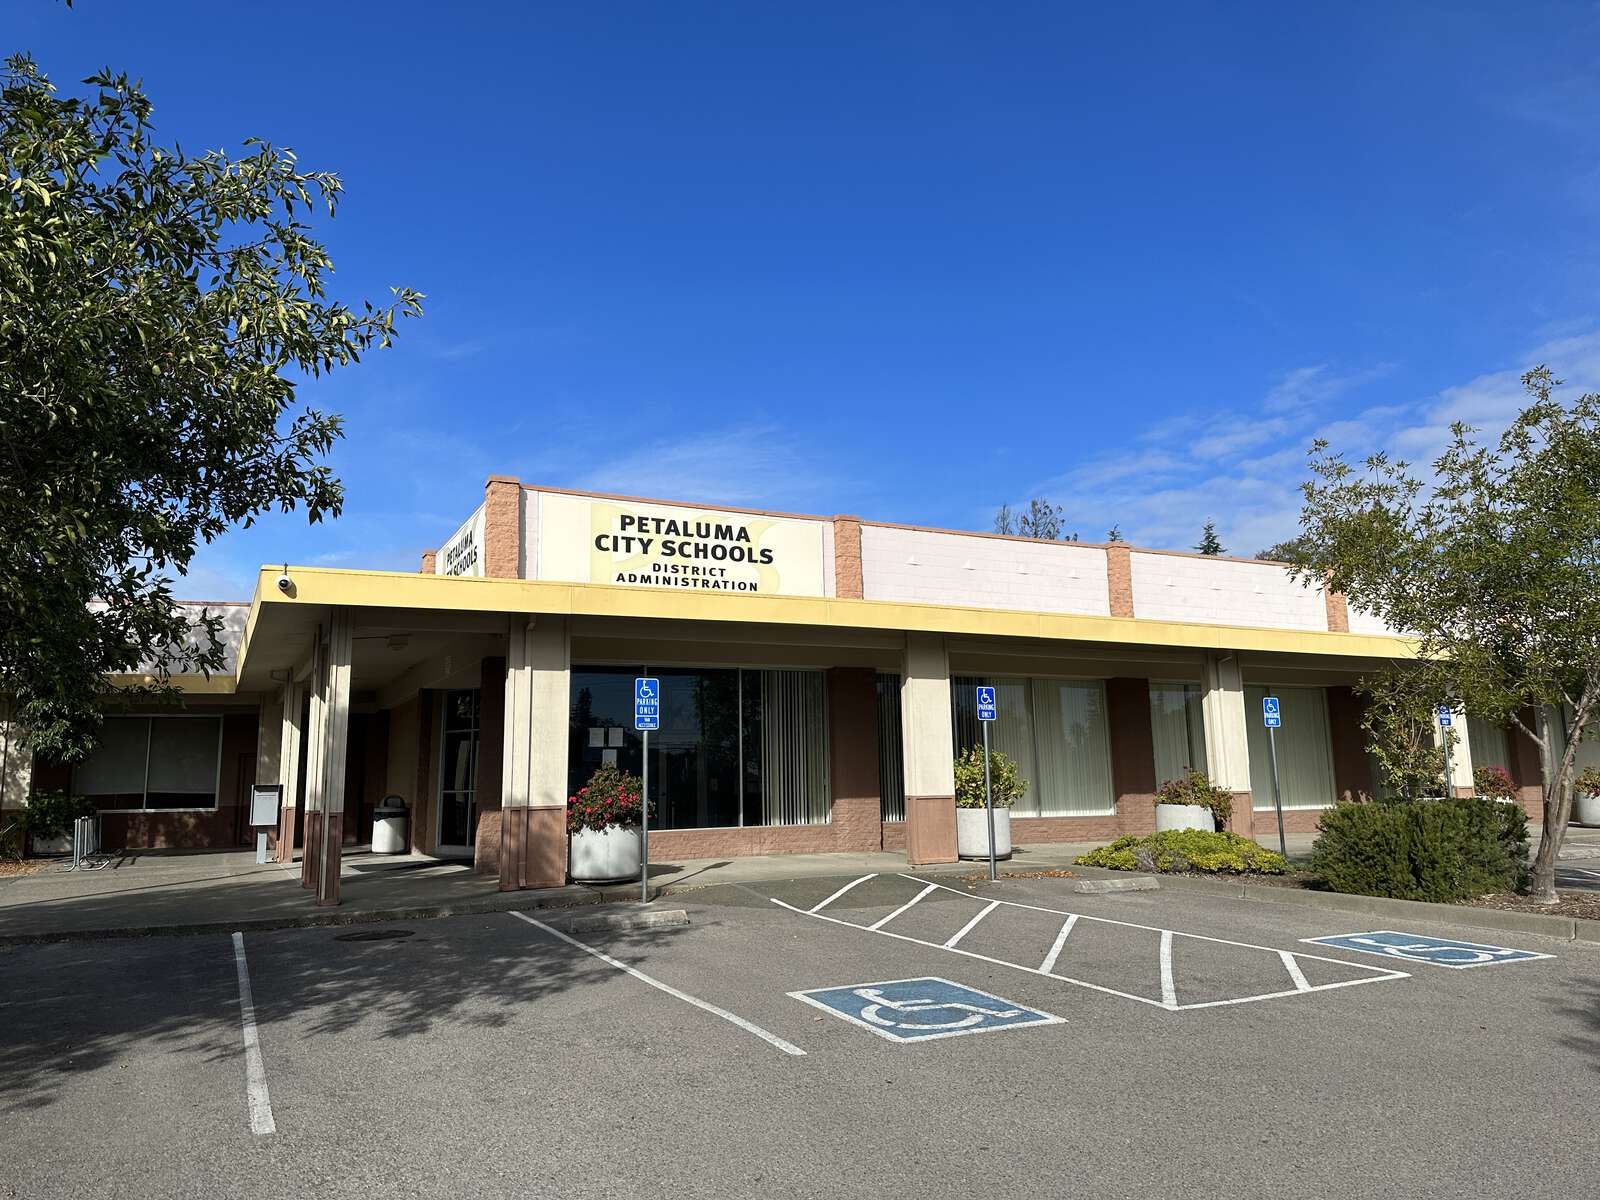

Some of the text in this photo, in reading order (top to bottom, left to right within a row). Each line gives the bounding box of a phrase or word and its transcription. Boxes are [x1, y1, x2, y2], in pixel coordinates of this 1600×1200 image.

[620, 514, 751, 542] PETALUMA
[446, 530, 473, 568] PETALUMA
[453, 545, 478, 576] SCHOOLS
[594, 534, 774, 564] CITY SCHOOLS
[652, 563, 726, 577] DISTRICT
[616, 573, 758, 591] ADMINISTRATION
[636, 698, 658, 706] PARKING
[640, 706, 655, 714] ONLY
